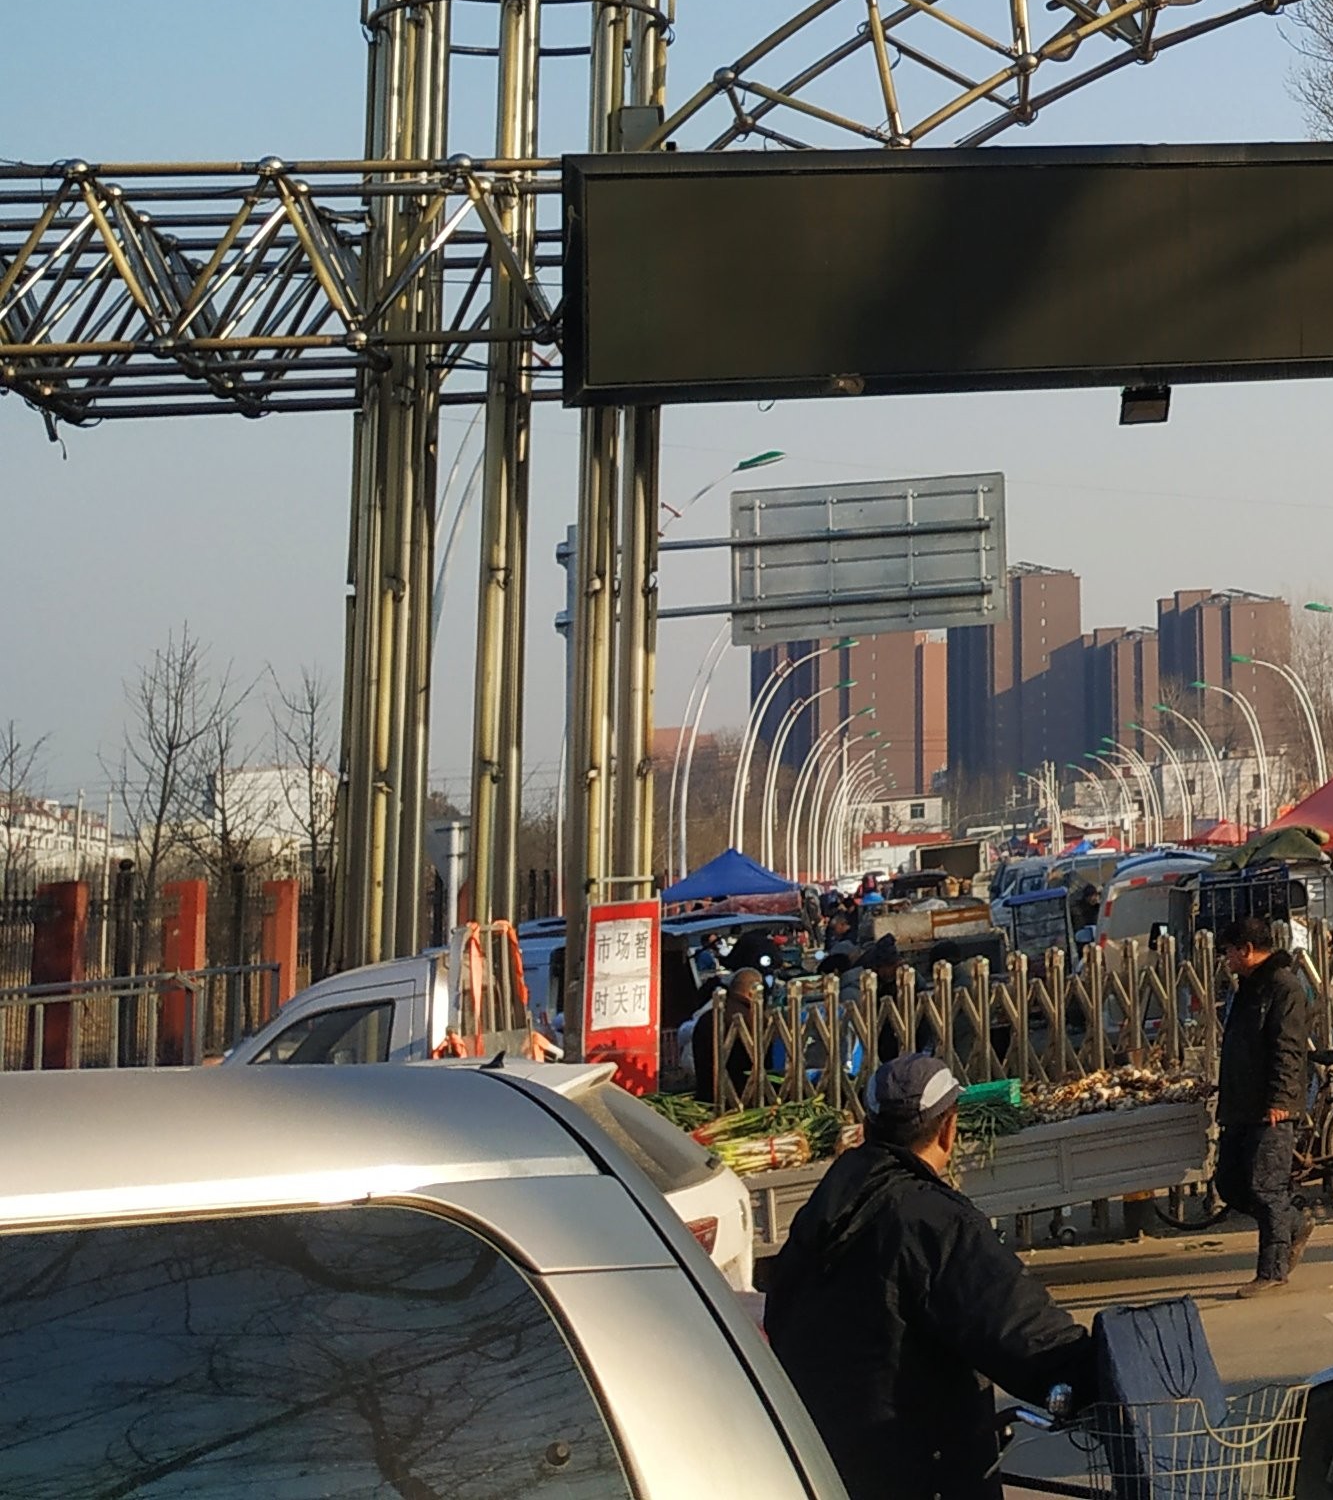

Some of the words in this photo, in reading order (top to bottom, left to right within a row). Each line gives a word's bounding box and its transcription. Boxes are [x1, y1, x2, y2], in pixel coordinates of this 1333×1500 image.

[596, 930, 649, 964] 市场暂
[594, 983, 647, 1017] 时关闭
